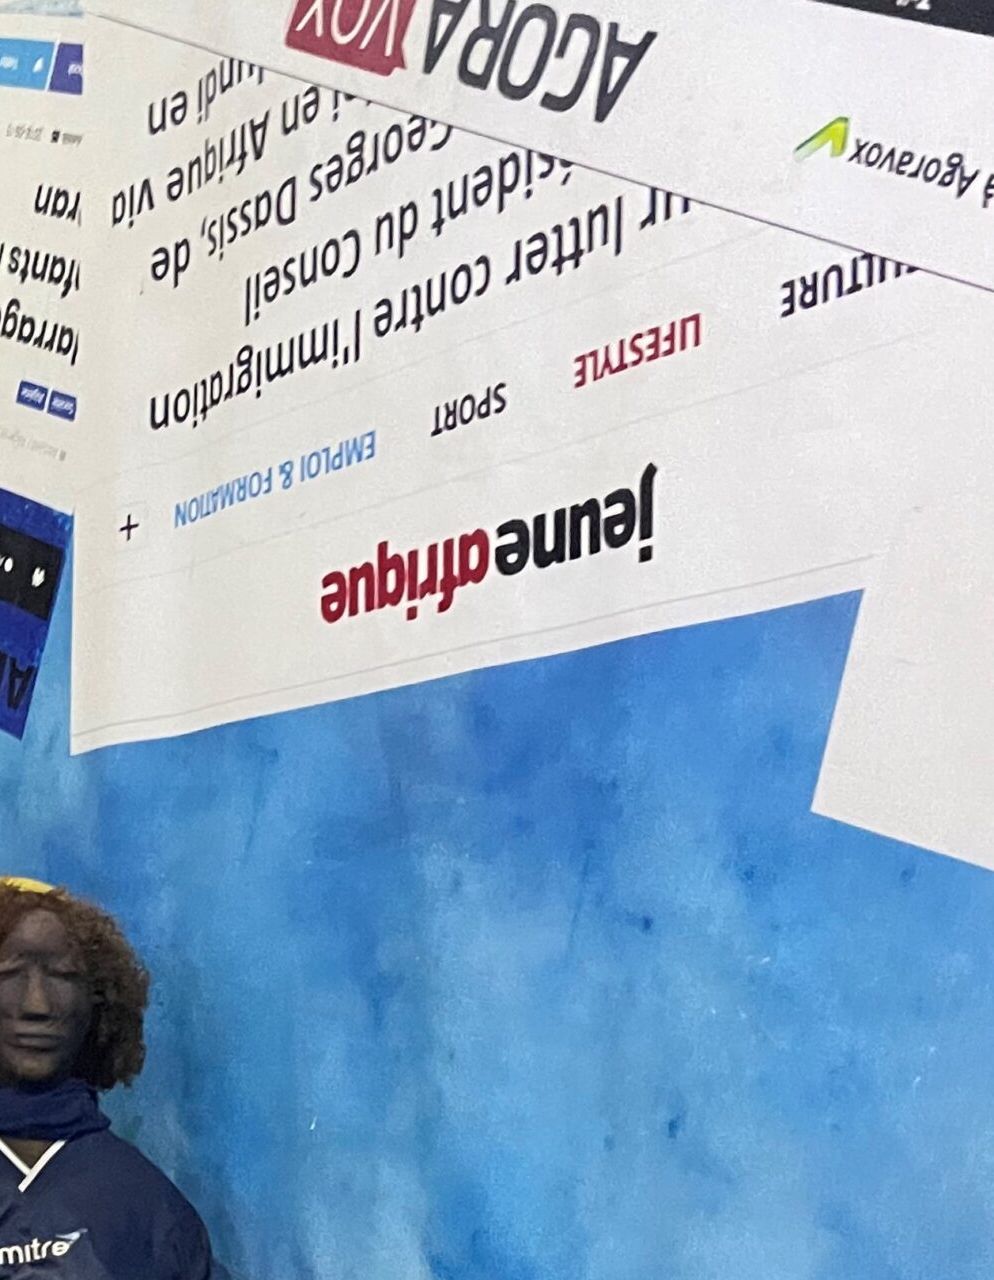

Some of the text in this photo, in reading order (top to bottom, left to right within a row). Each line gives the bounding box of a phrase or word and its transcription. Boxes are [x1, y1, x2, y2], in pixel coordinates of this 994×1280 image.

[423, 0, 657, 123] AGORA
[148, 91, 188, 135] en
[281, 85, 320, 137] en
[166, 110, 270, 203] Afrique
[848, 138, 981, 199] Agoravox
[34, 183, 81, 227] ran
[111, 178, 155, 230] via
[201, 176, 297, 262] Dassis,
[375, 200, 418, 259] du
[504, 195, 624, 287] lutter
[150, 237, 190, 289] de
[244, 229, 362, 327] Conseil
[373, 254, 490, 335] contre
[149, 308, 362, 431] l'immigration
[573, 312, 702, 389] LIFESTYLE
[430, 382, 507, 437] SPORT
[173, 429, 377, 529] EMPLOI & FORMATION
